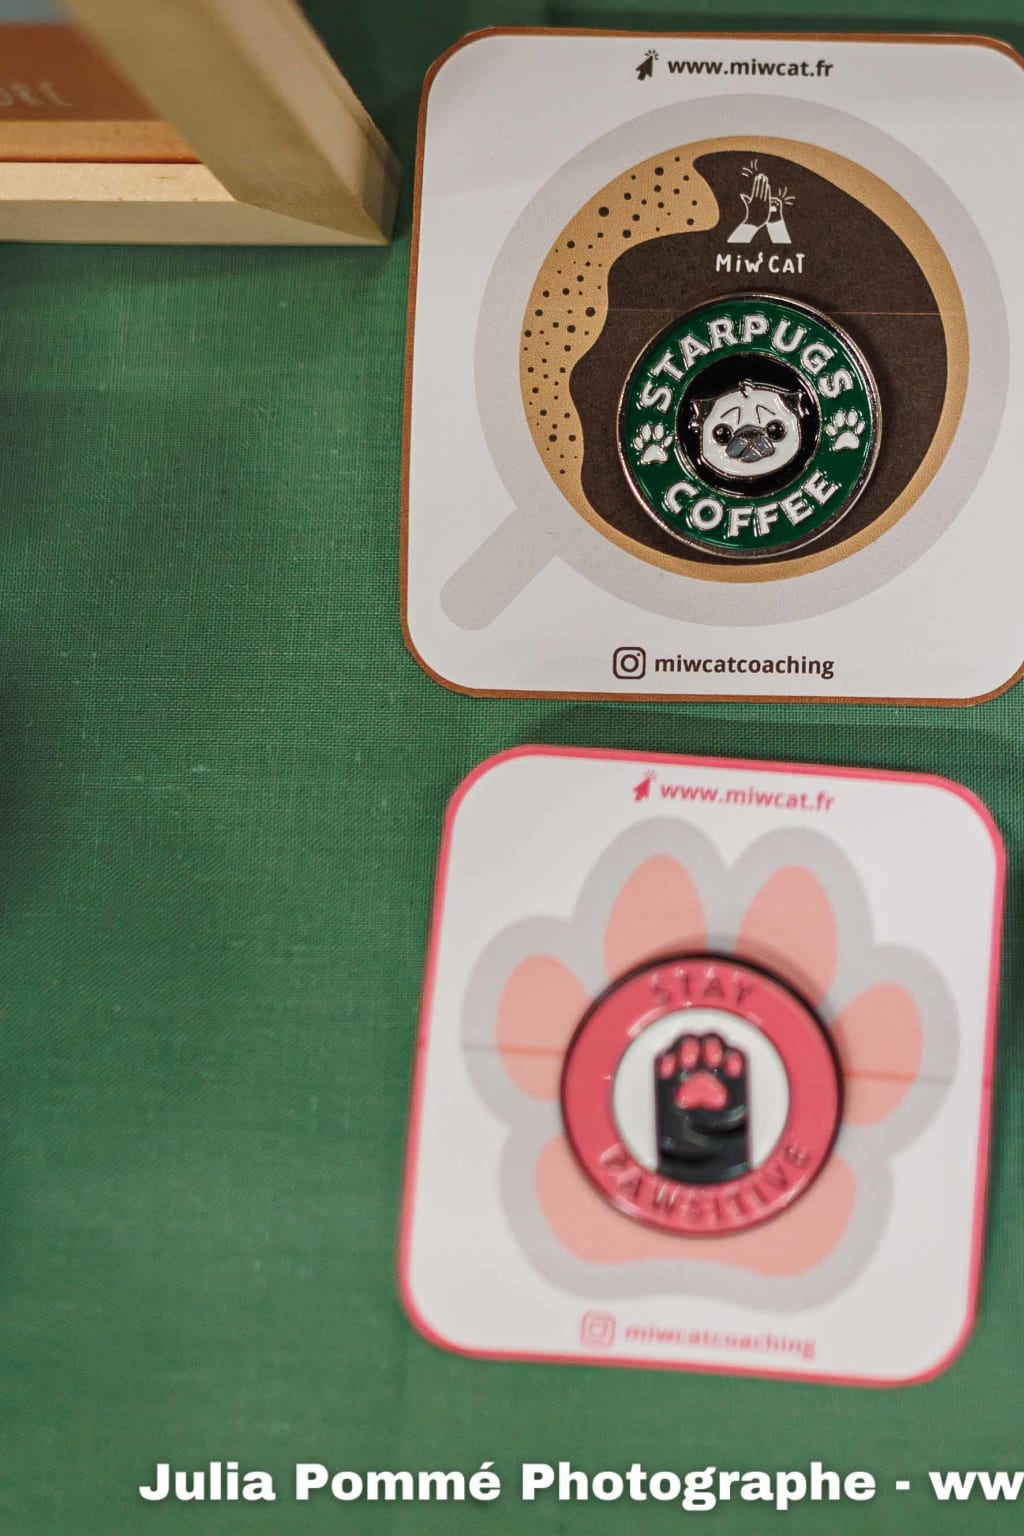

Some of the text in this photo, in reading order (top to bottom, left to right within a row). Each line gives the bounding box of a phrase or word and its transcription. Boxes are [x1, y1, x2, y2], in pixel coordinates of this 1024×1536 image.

[667, 56, 833, 78] www.miwcat.fr
[640, 313, 854, 412] STARPUGS
[664, 470, 840, 538] COFFEE
[655, 653, 834, 680] miwcatcoaching
[660, 783, 834, 813] www.miwcat.fr
[650, 966, 752, 1007] STAY
[600, 1142, 808, 1224] PAWSITIVE
[625, 1323, 816, 1360] miwcatcoaching
